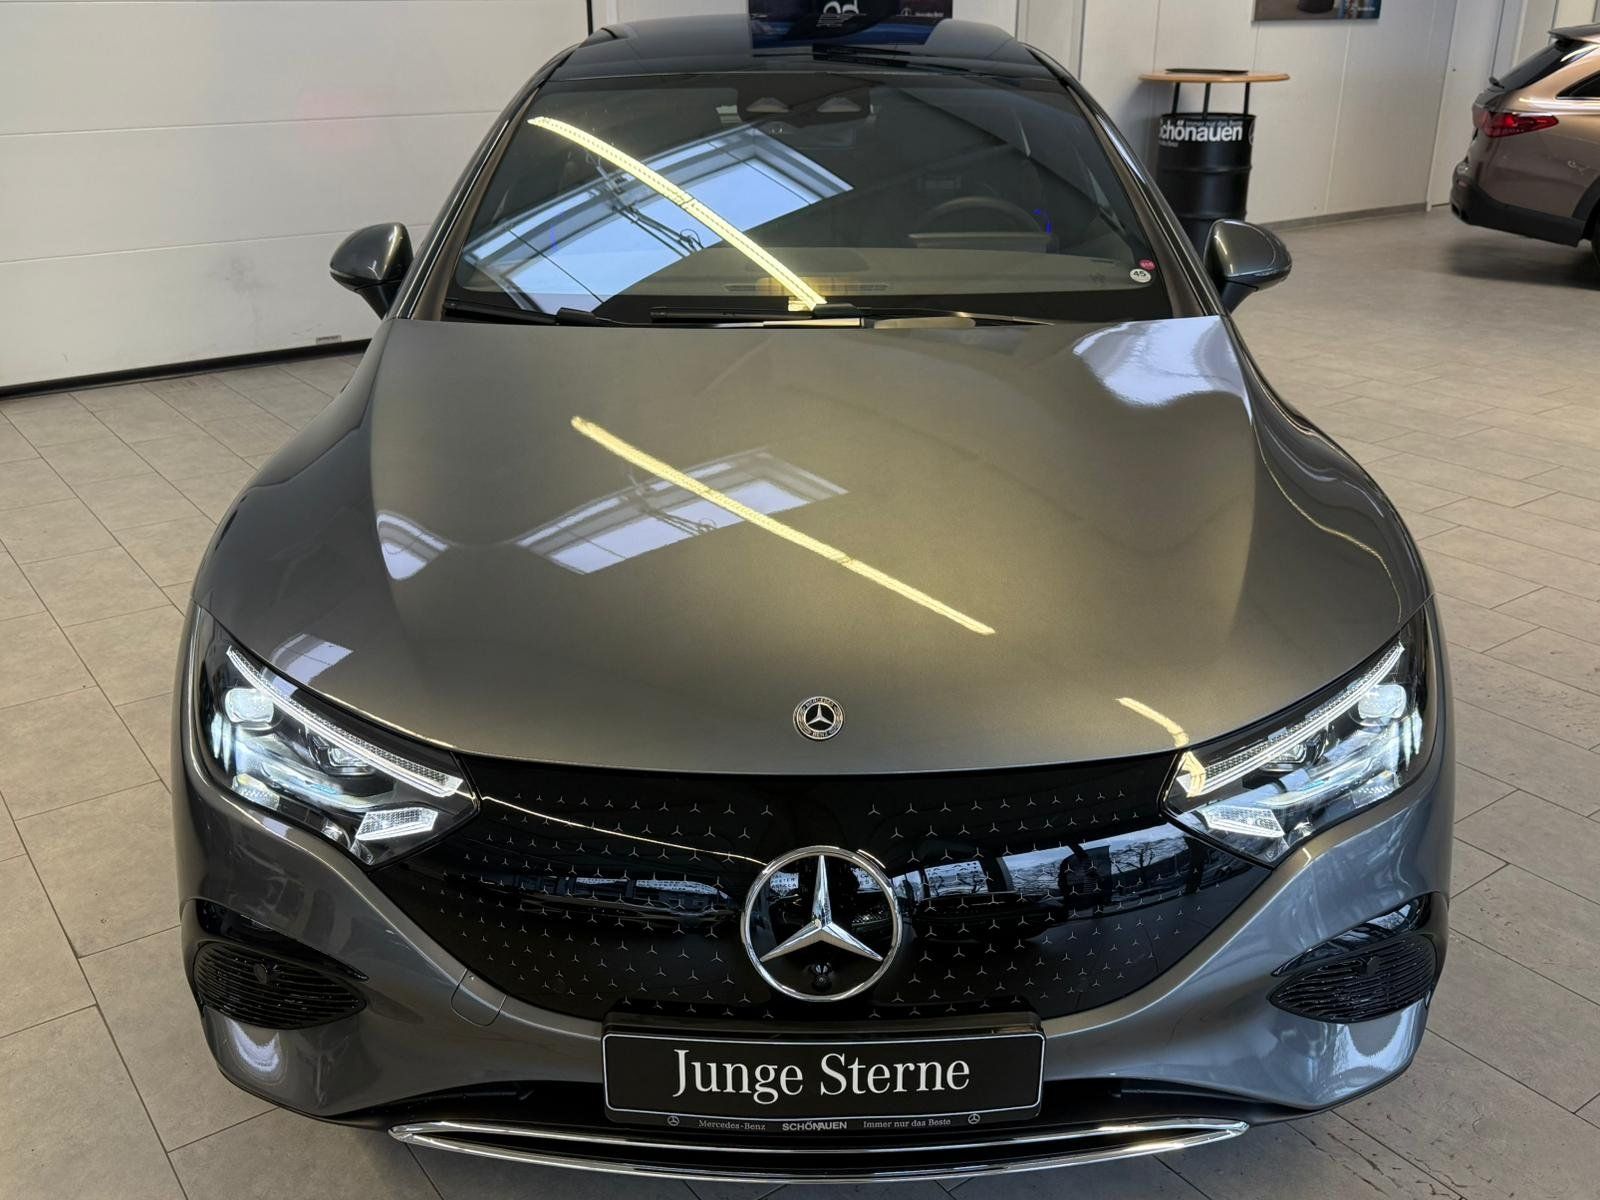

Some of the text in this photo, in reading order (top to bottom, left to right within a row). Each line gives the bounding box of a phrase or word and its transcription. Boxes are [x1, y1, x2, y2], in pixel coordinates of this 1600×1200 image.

[672, 1048, 970, 1105] Junge Sterne
[698, 1119, 766, 1131] Mercedes-Benz
[782, 1120, 848, 1132] SCHÖNAUEN
[863, 1120, 892, 1128] Immer
[893, 1120, 910, 1128] nur
[911, 1119, 927, 1127] das
